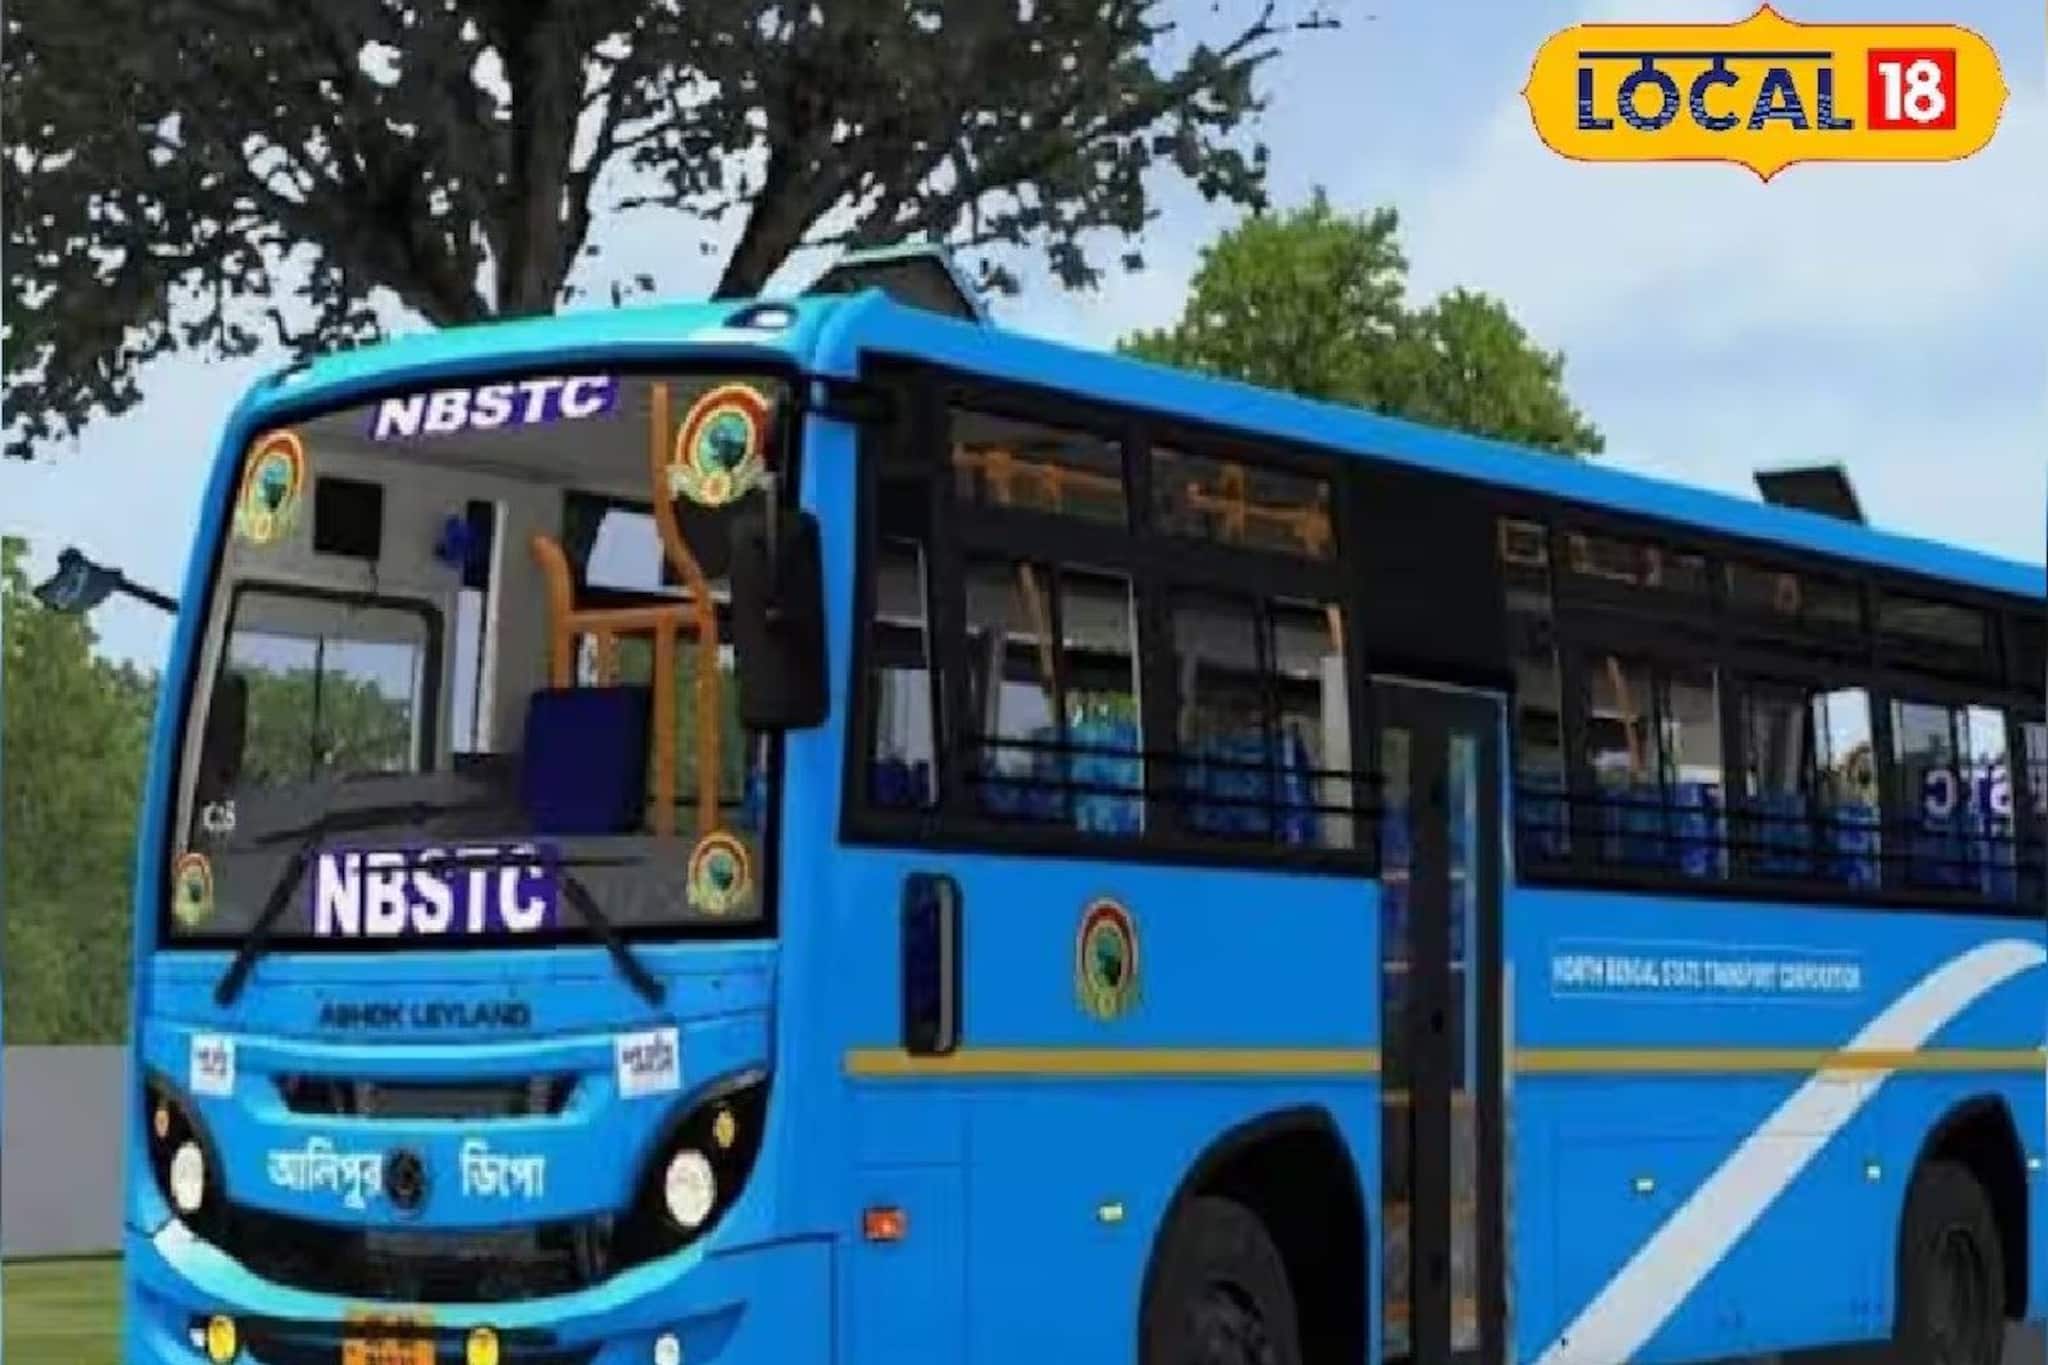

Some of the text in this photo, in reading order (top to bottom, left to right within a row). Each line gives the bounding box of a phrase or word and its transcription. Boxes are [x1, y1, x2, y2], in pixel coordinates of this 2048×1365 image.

[374, 375, 610, 441] NBSTC
[314, 842, 546, 938] NBSTC
[411, 1003, 531, 1029] LEYLAND
